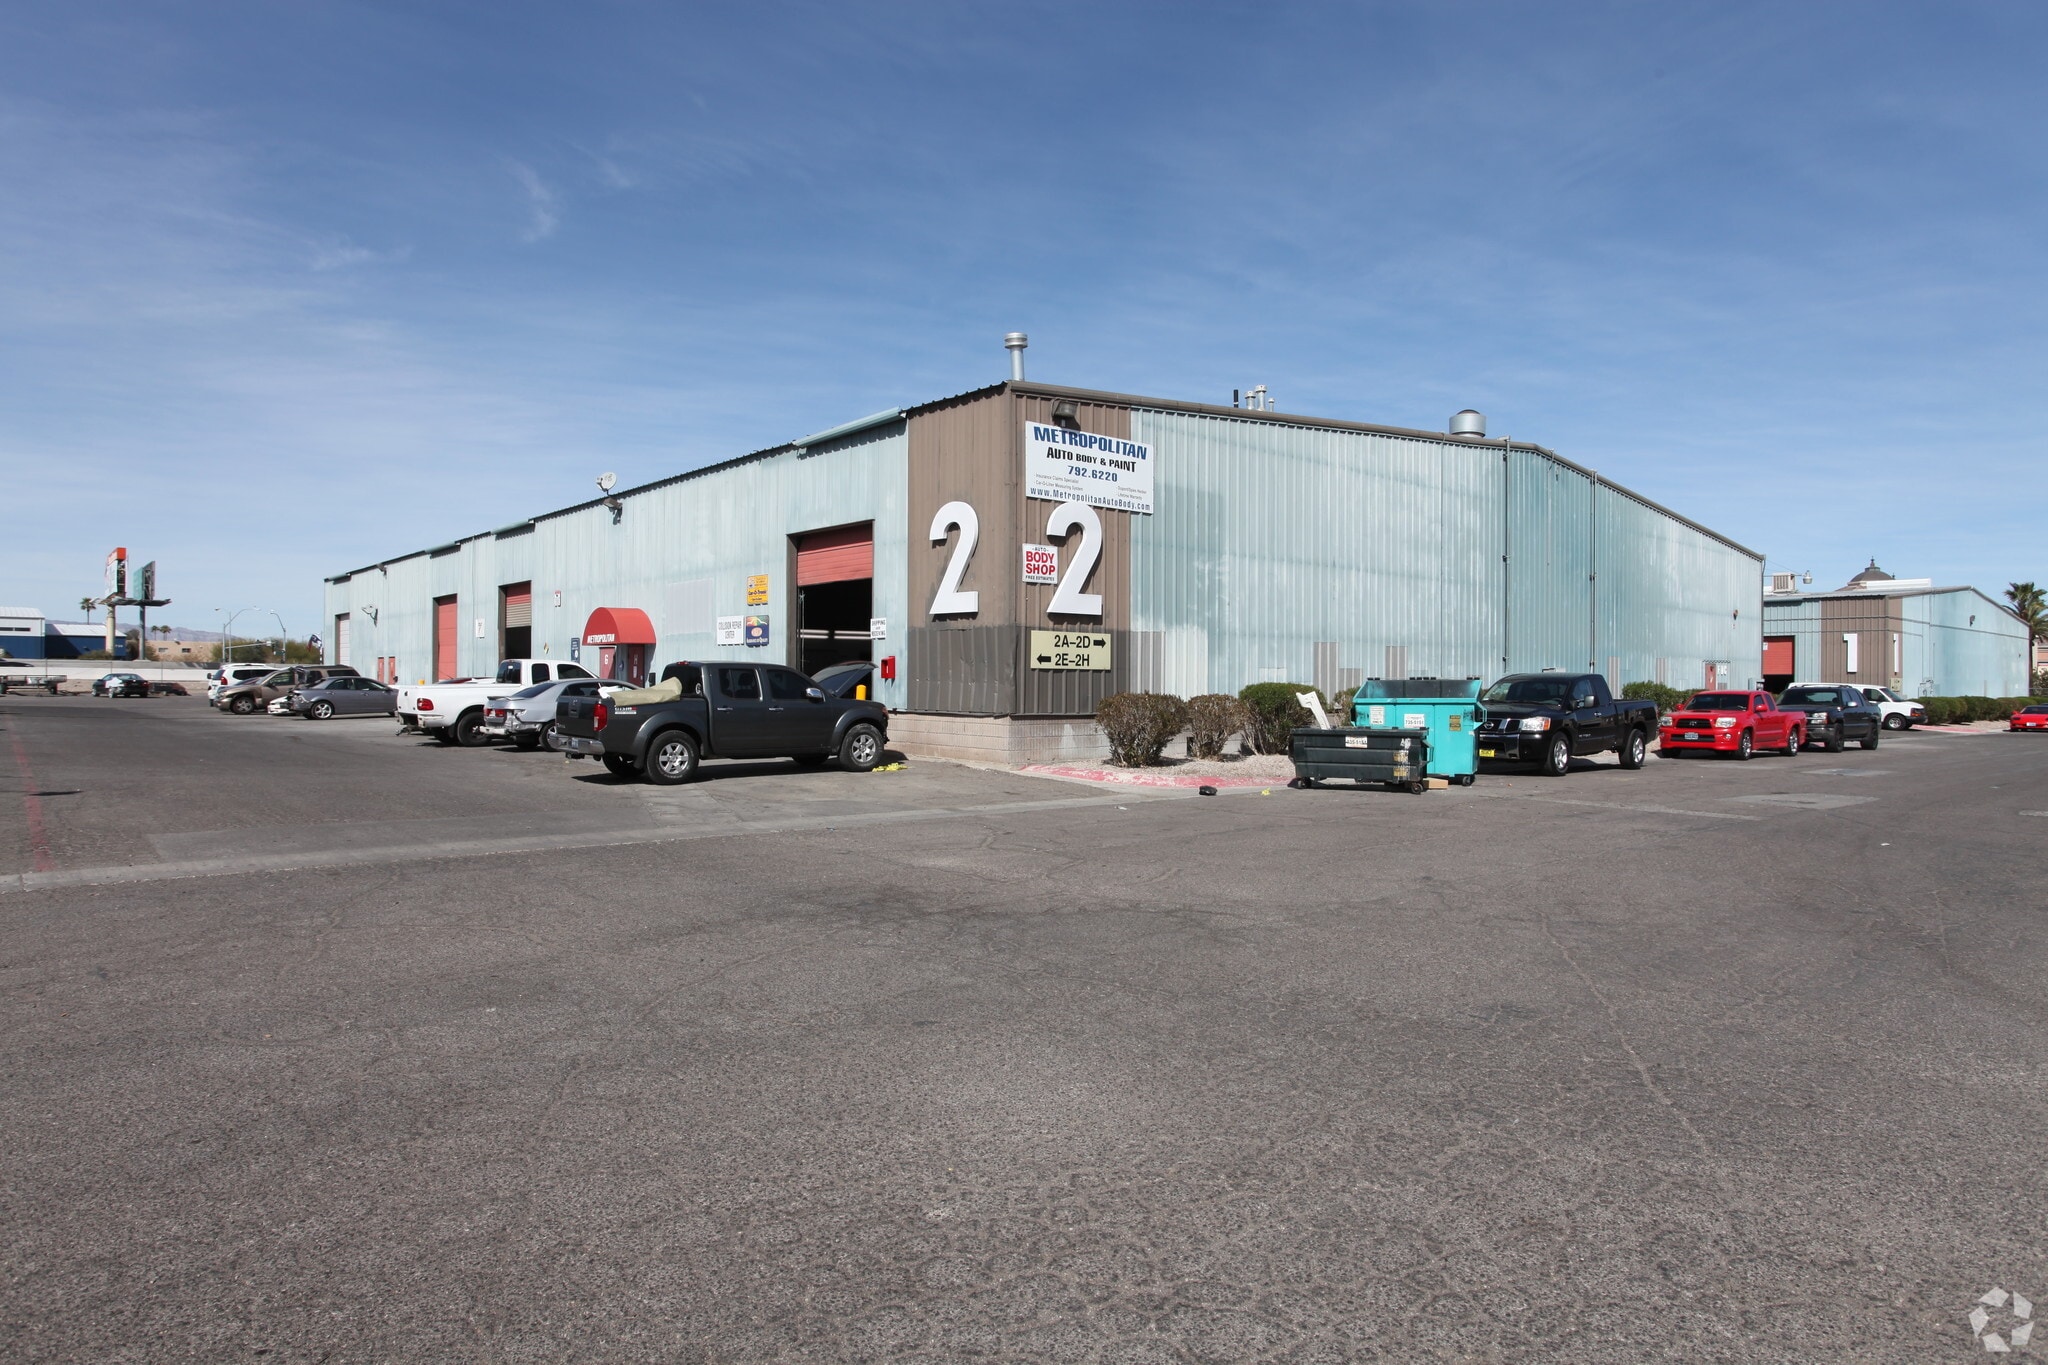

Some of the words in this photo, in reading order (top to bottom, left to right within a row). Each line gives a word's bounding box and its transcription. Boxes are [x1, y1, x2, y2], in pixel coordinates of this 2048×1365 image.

[1034, 426, 1147, 460] METROPOLITAN
[1047, 447, 1073, 460] AUTO
[1076, 454, 1098, 464] BODY
[1100, 458, 1106, 466] &
[1109, 459, 1136, 472] PAINT
[1068, 465, 1118, 482] 792.6220
[1030, 487, 1151, 511] www.MetropolitanAutoBody.com
[929, 501, 979, 614] 2
[1026, 551, 1054, 564] BODY
[1046, 502, 1102, 615] 2
[1026, 563, 1055, 575] SHOP
[587, 633, 615, 643] METROPOLITAN
[1054, 634, 1091, 648] 2A-2D
[1055, 653, 1090, 666] 2E-2H
[1843, 633, 1858, 673] 1
